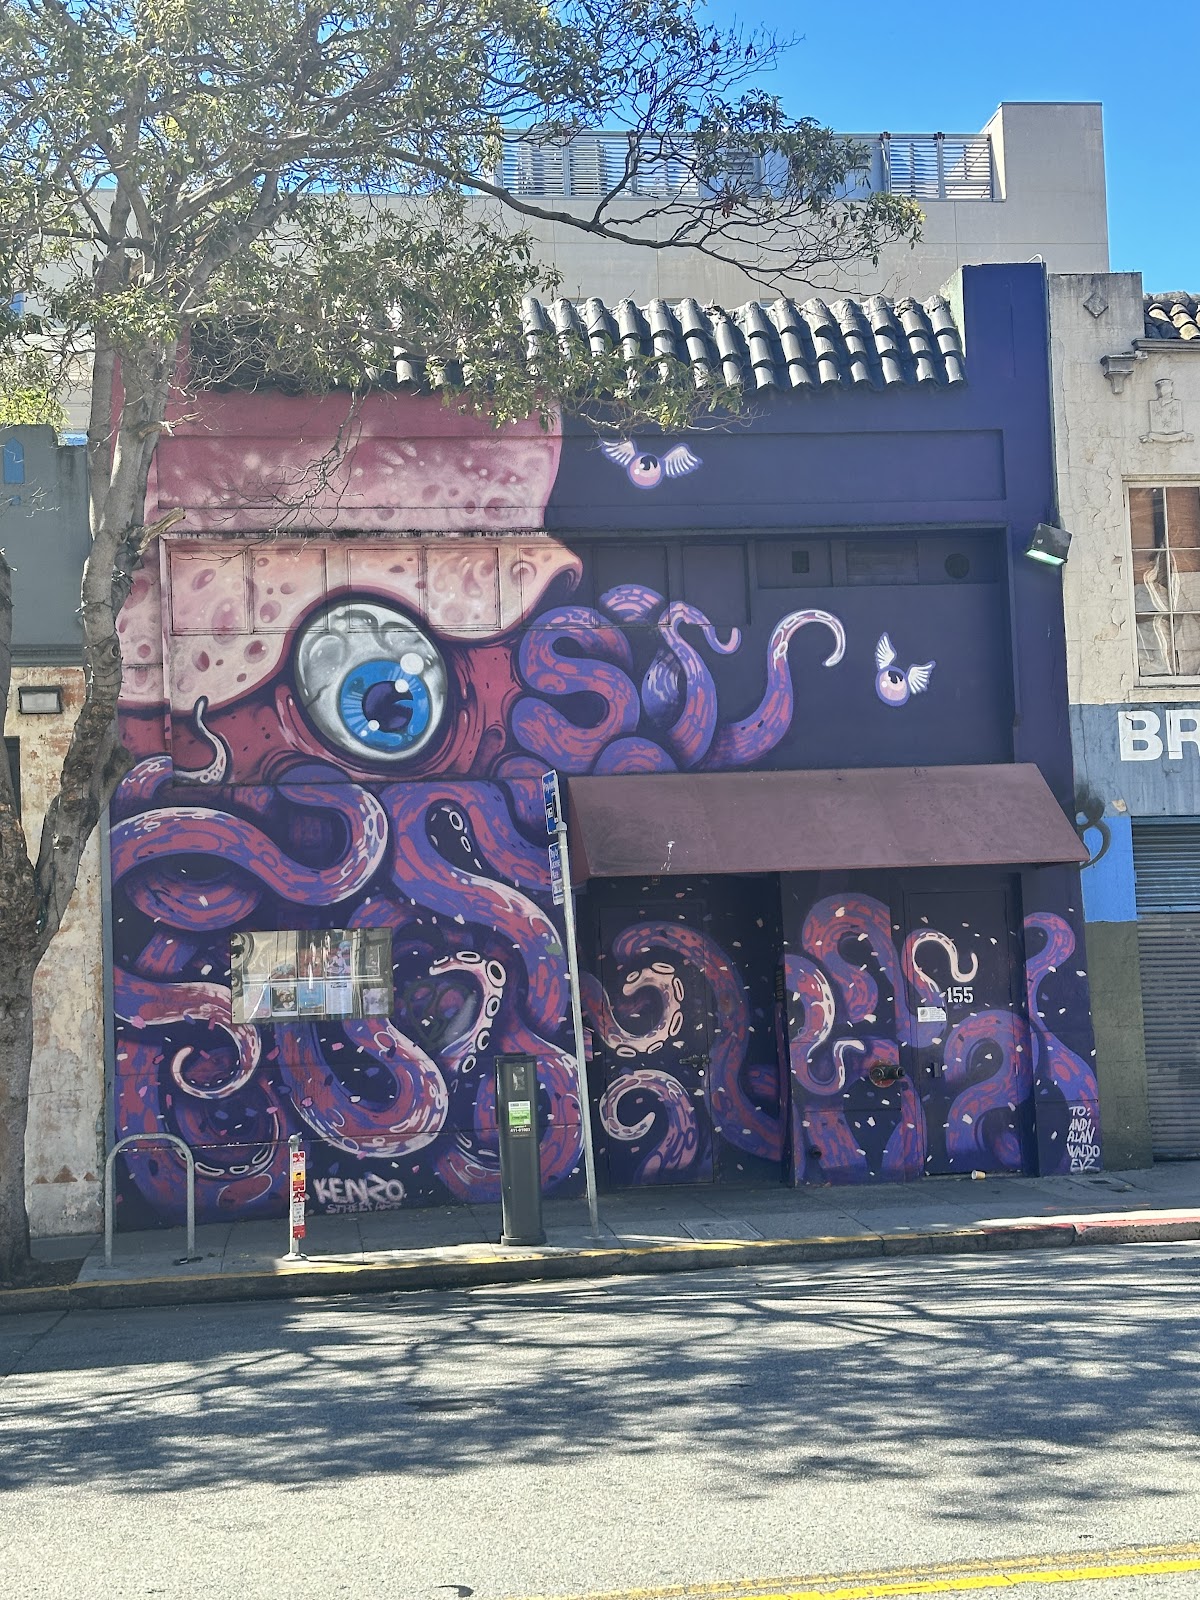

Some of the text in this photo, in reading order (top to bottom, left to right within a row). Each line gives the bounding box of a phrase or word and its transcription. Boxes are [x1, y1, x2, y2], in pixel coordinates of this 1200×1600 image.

[946, 986, 974, 1003] 155
[1068, 1106, 1091, 1116] TO:
[1066, 1127, 1096, 1144] ALAN
[1066, 1143, 1101, 1158] WALDO
[312, 1173, 404, 1204] KENZO
